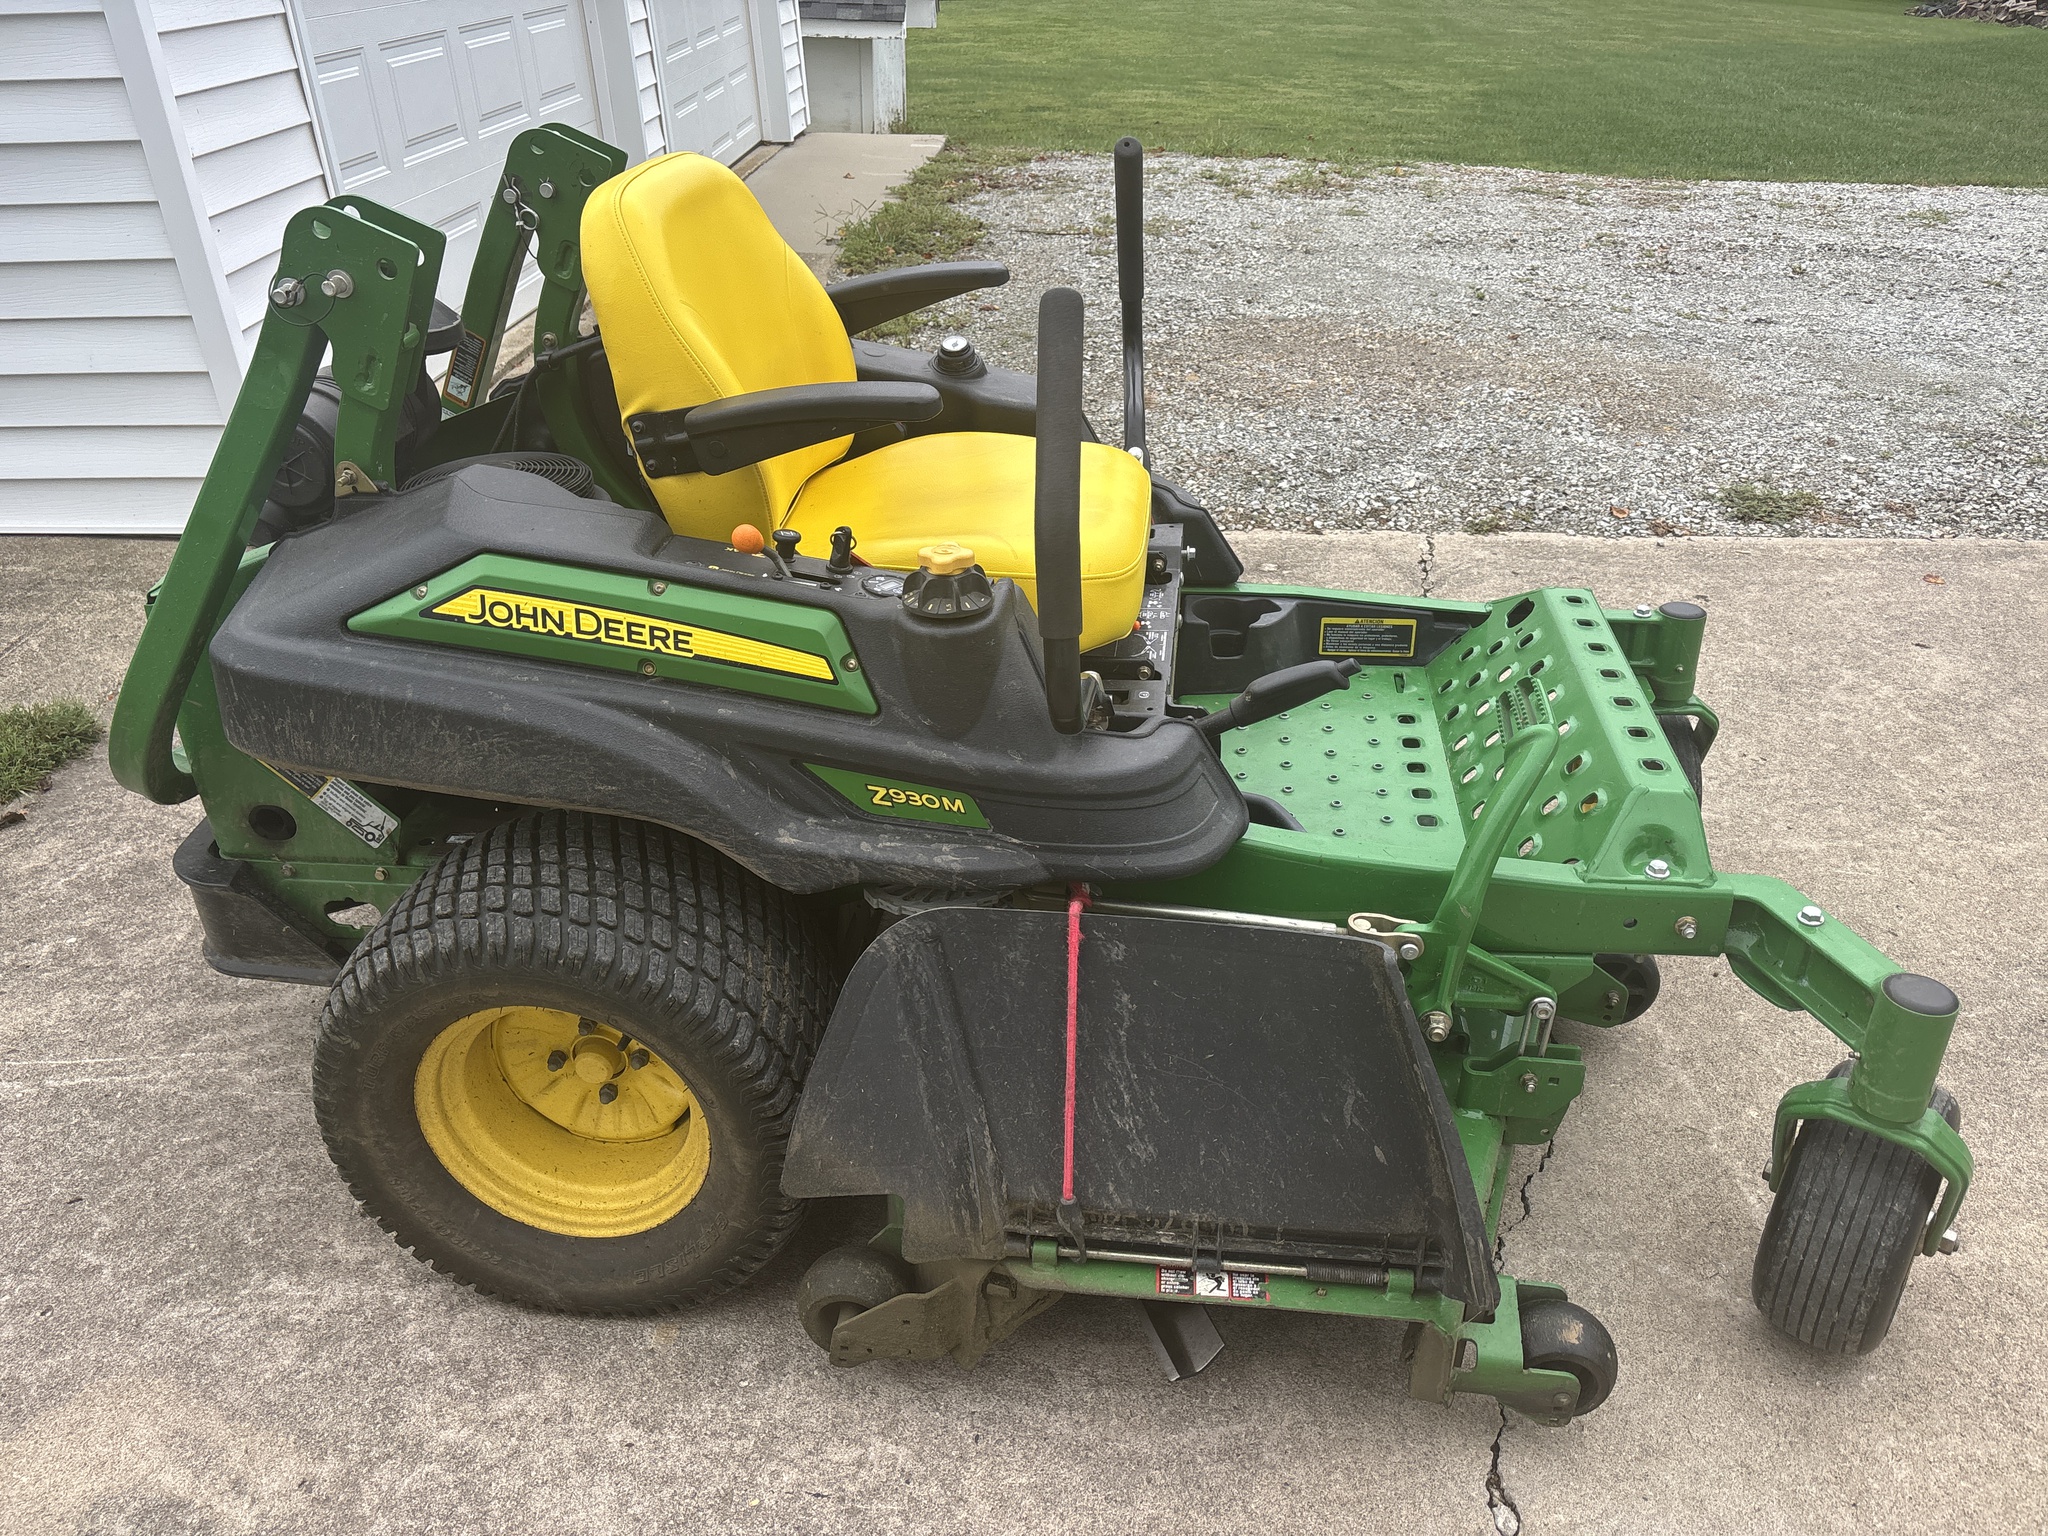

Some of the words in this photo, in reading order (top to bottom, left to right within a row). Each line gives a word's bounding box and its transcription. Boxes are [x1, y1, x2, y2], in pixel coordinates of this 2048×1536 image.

[468, 594, 565, 632] JOHN
[574, 608, 694, 654] DEERE
[866, 783, 967, 814] Z930M
